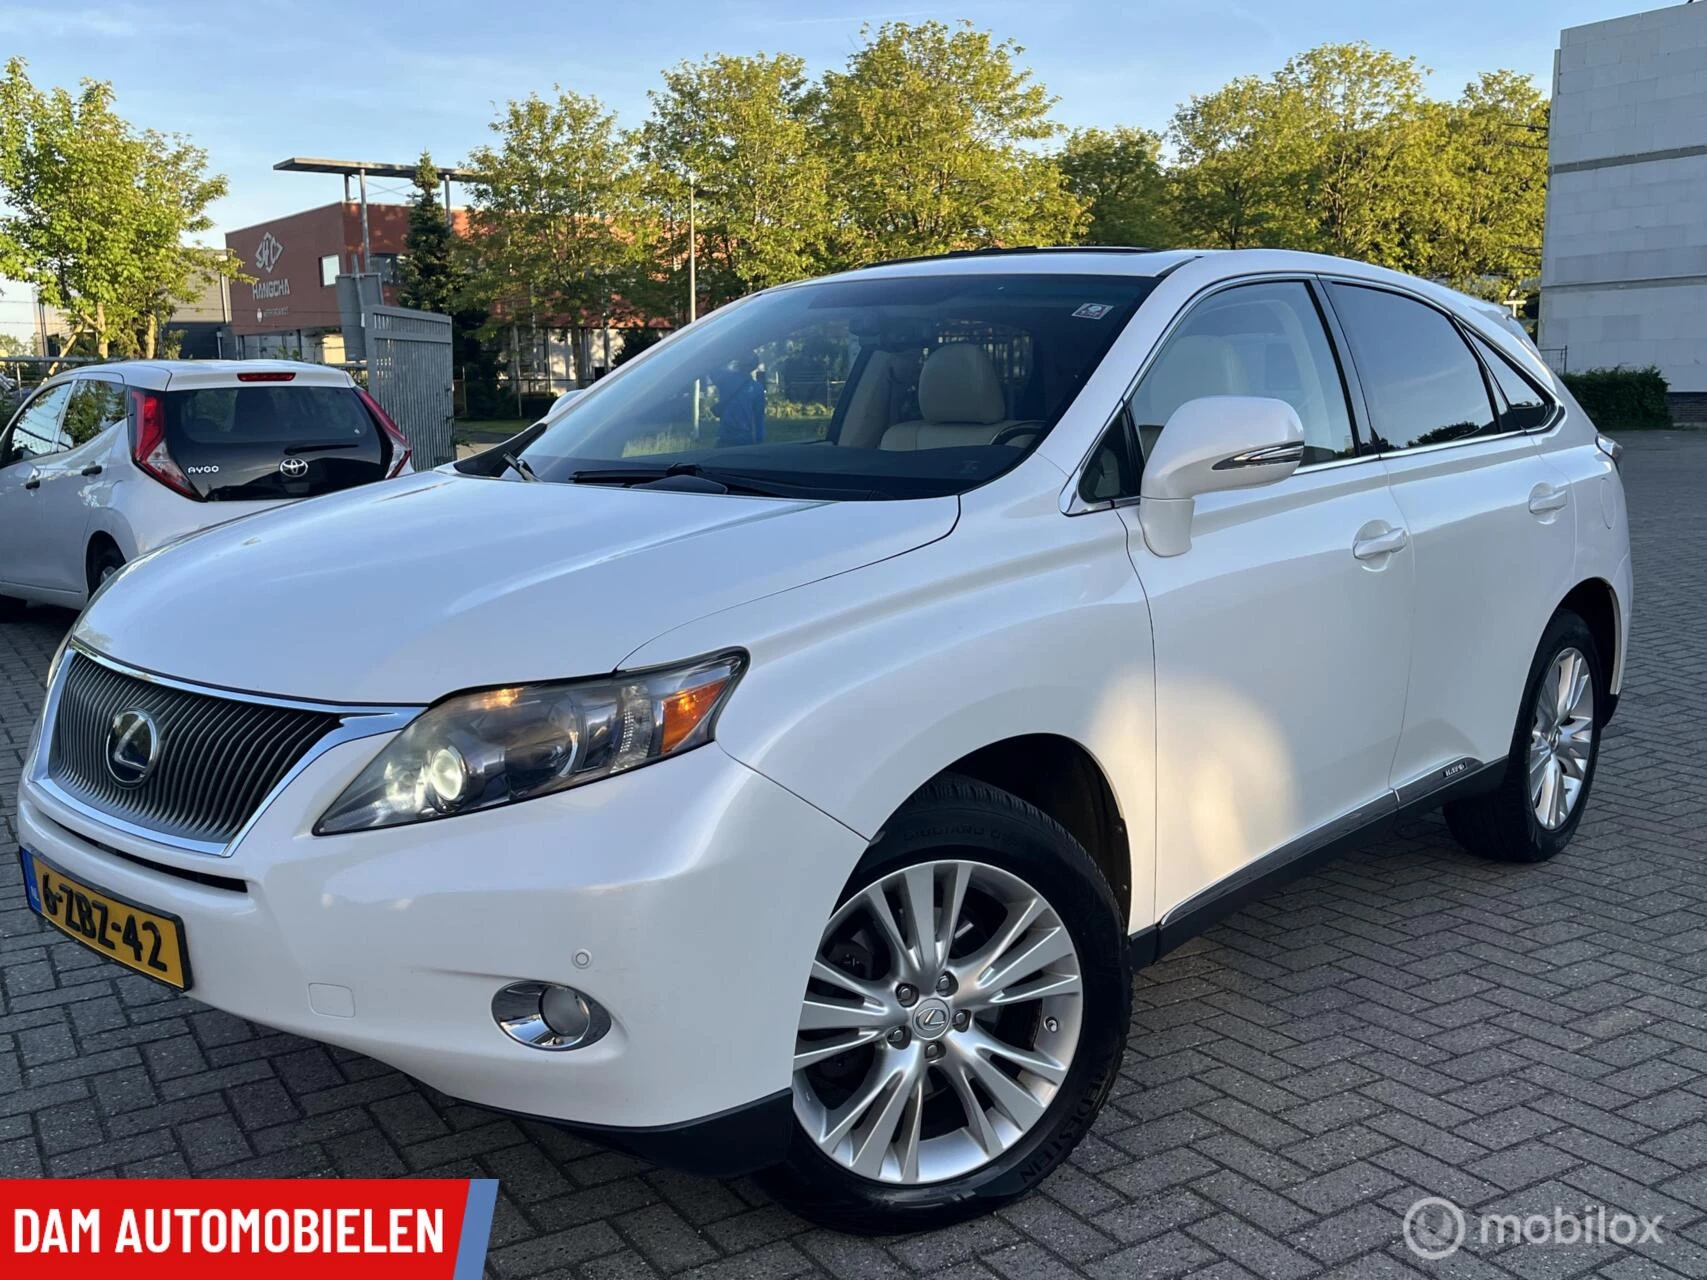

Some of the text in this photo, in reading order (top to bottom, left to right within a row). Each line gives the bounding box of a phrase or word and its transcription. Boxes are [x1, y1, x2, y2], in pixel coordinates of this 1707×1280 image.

[252, 278, 290, 300] HANGCHA
[187, 465, 220, 474] AYGO
[42, 872, 168, 972] 6-ZBZ-42
